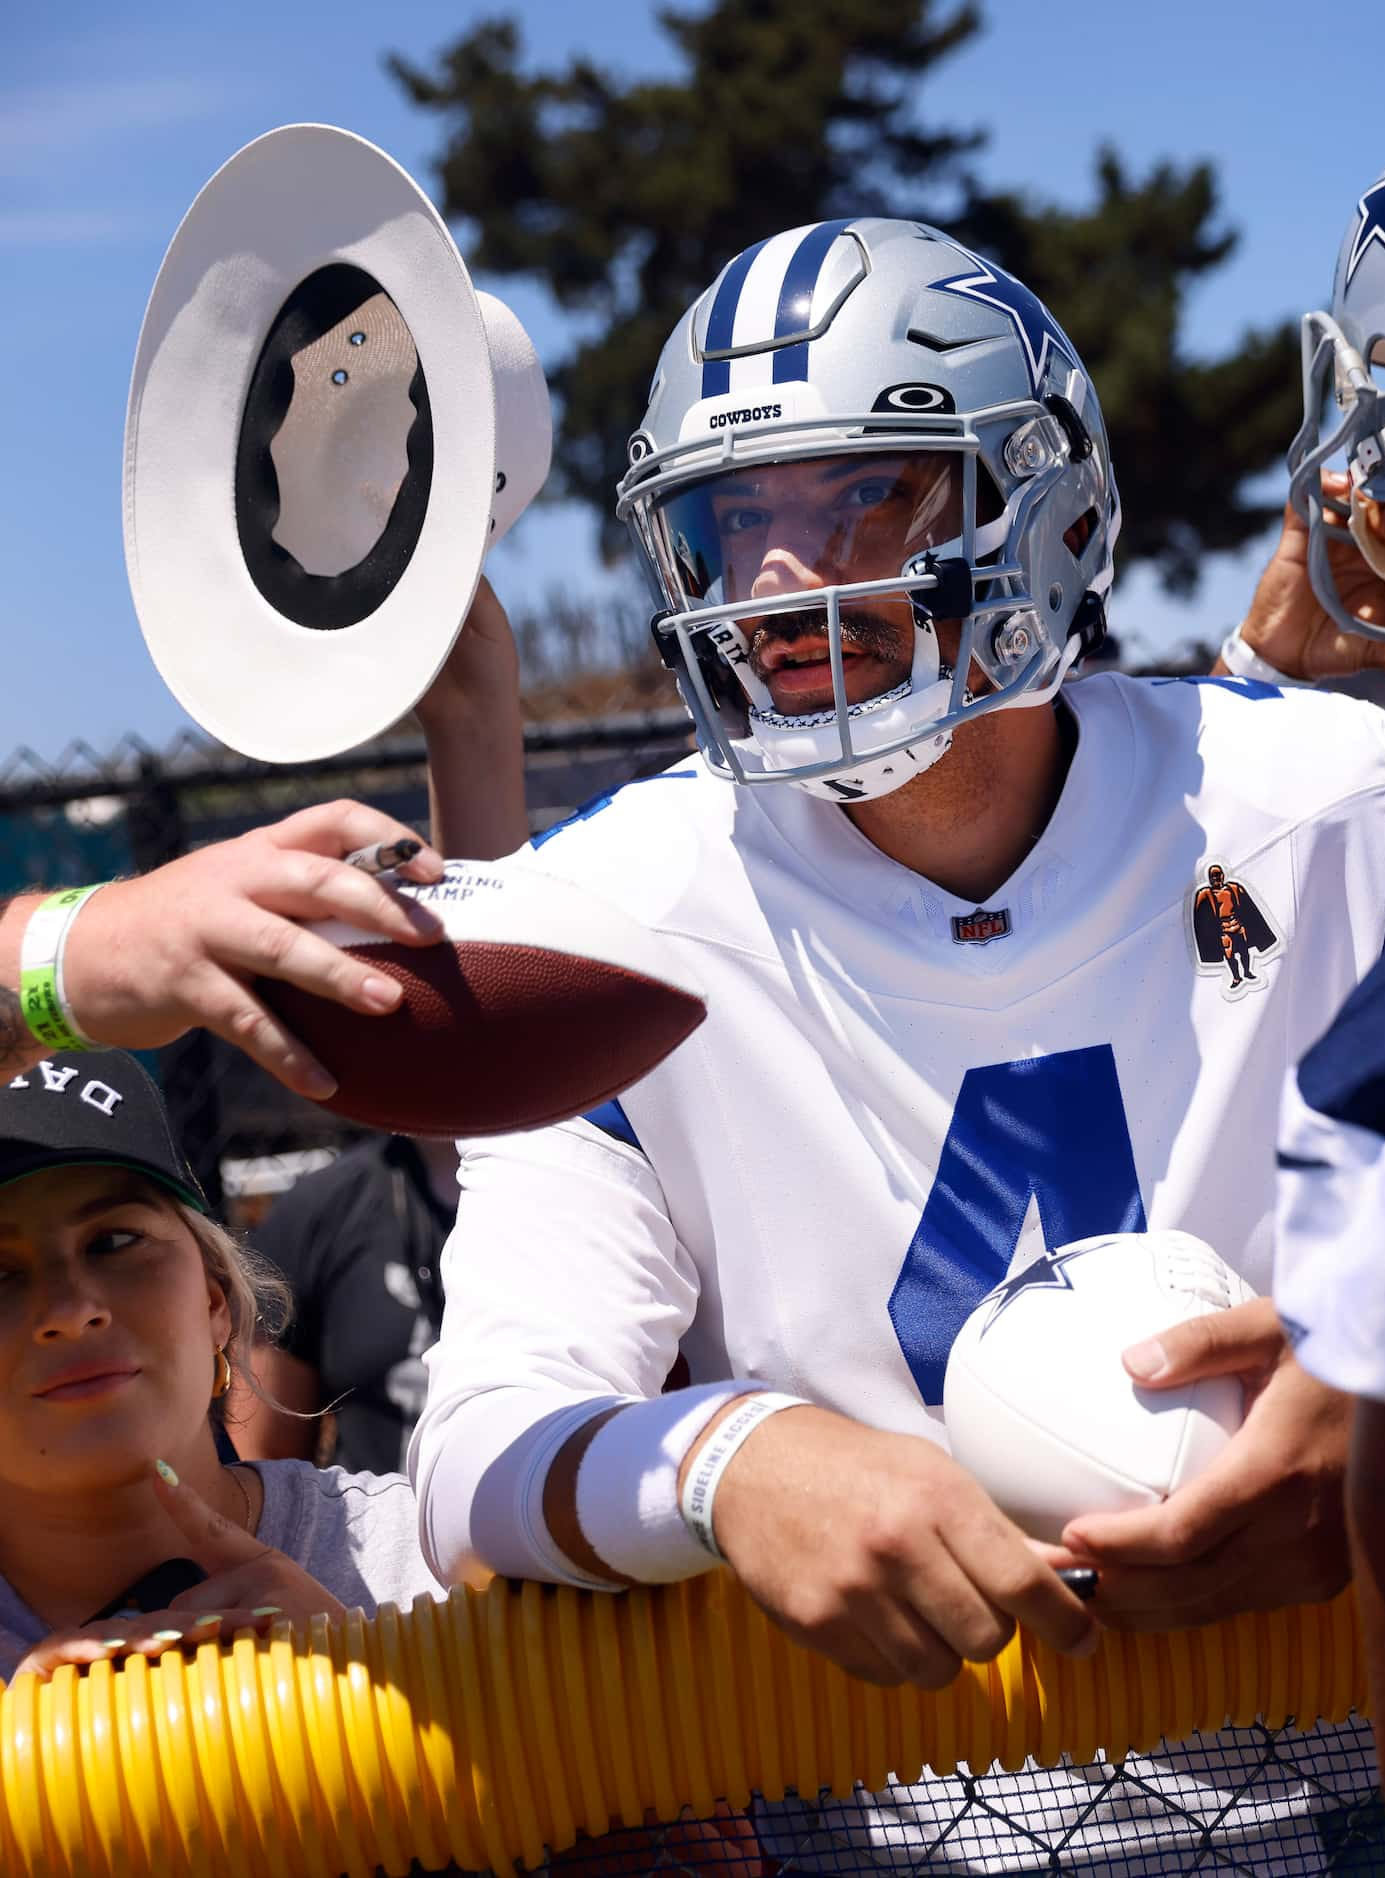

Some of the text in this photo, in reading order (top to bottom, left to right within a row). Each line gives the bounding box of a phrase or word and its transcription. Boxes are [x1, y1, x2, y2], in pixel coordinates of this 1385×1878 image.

[710, 404, 782, 429] COWBOYS
[960, 919, 1004, 939] NFL
[692, 1447, 727, 1513] SIDELINE
